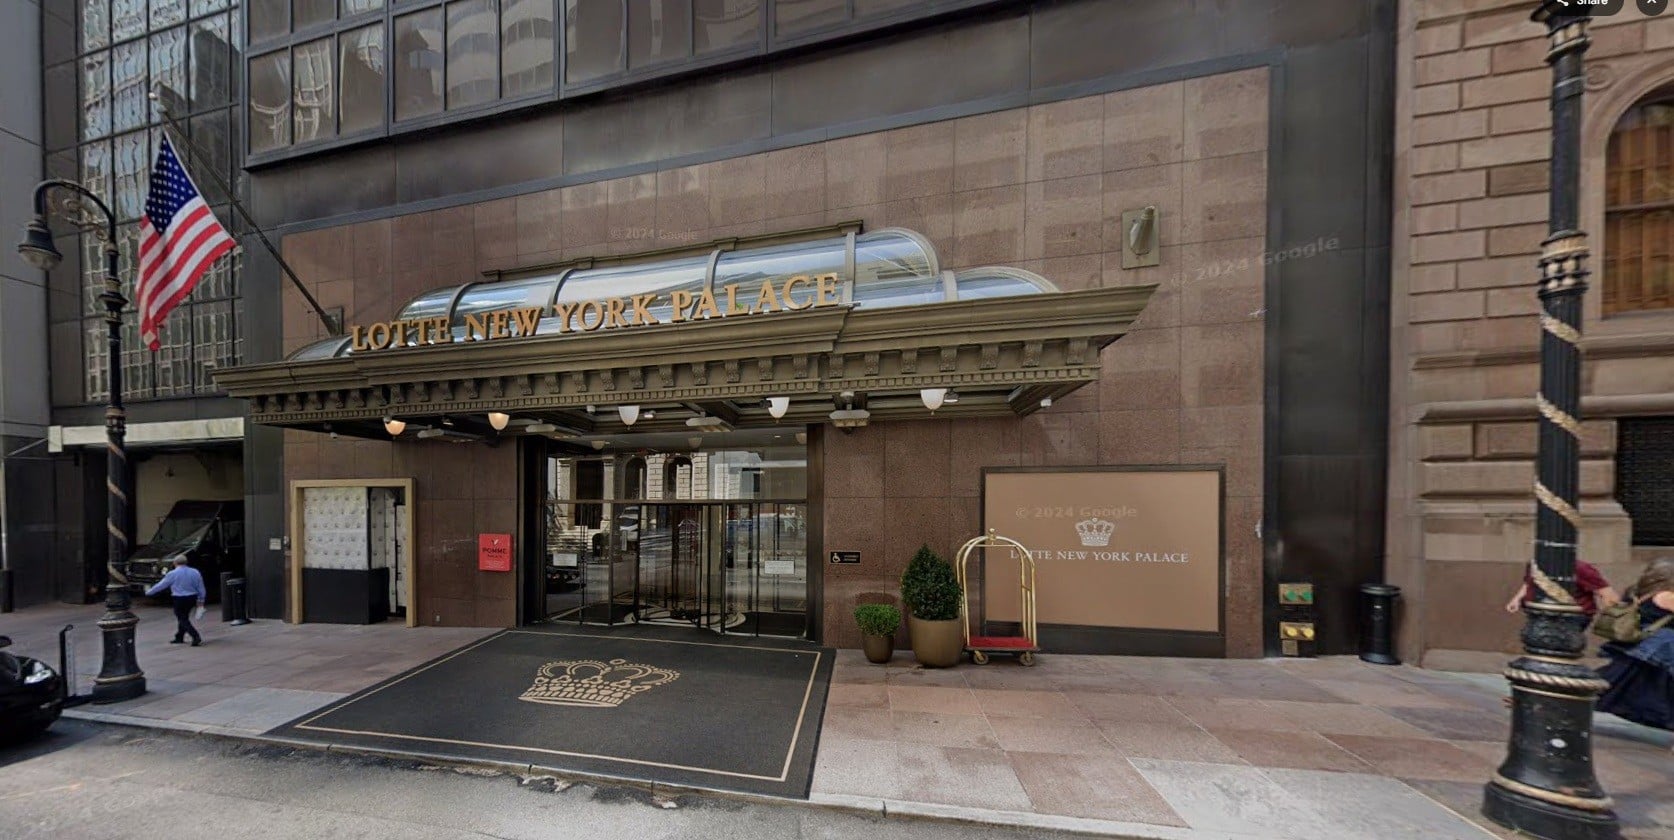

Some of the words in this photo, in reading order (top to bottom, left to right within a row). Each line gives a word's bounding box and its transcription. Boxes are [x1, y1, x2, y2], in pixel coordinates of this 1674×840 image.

[352, 315, 453, 350] LOTTE
[464, 306, 544, 342] NEW
[554, 293, 660, 334] YORK
[670, 272, 839, 323] PALACE
[1010, 550, 1052, 560] LTTE
[1057, 551, 1088, 560] NEW
[1093, 551, 1131, 562] YORK
[1135, 552, 1190, 563] PALACE
